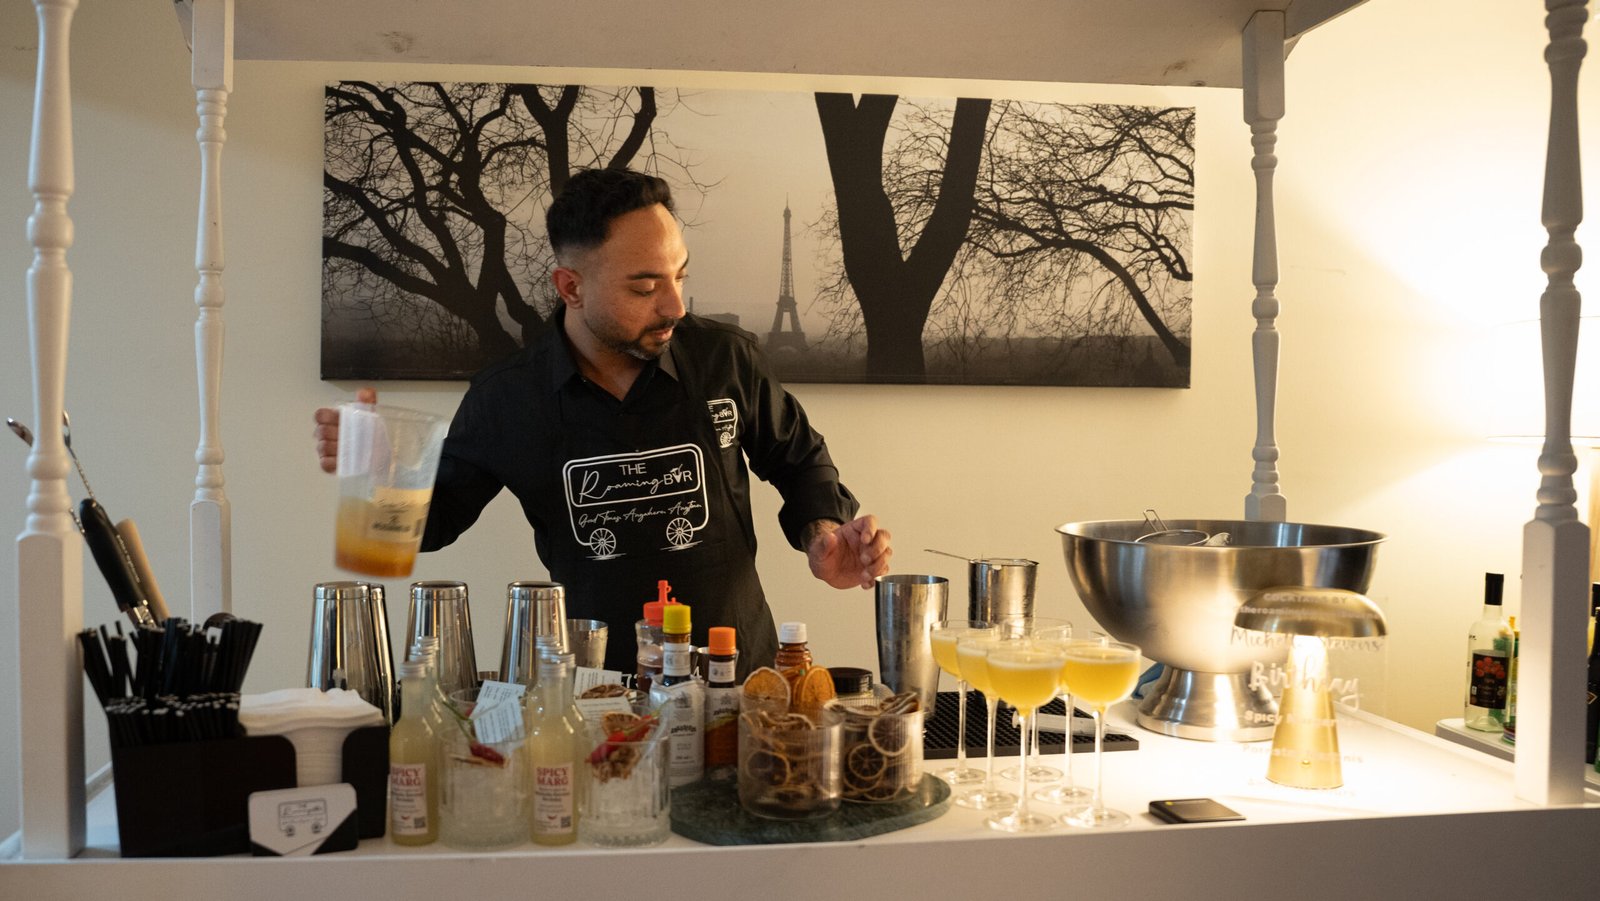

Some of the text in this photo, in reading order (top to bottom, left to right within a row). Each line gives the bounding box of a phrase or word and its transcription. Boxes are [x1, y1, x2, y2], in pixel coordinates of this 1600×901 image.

[619, 463, 647, 476] THE
[579, 470, 664, 504] Roaming
[1263, 593, 1327, 604] COCKTAS
[1248, 656, 1362, 711] Birhay
[1244, 710, 1282, 726] Spicy
[537, 767, 568, 777] SPICY
[537, 775, 569, 786] MARG
